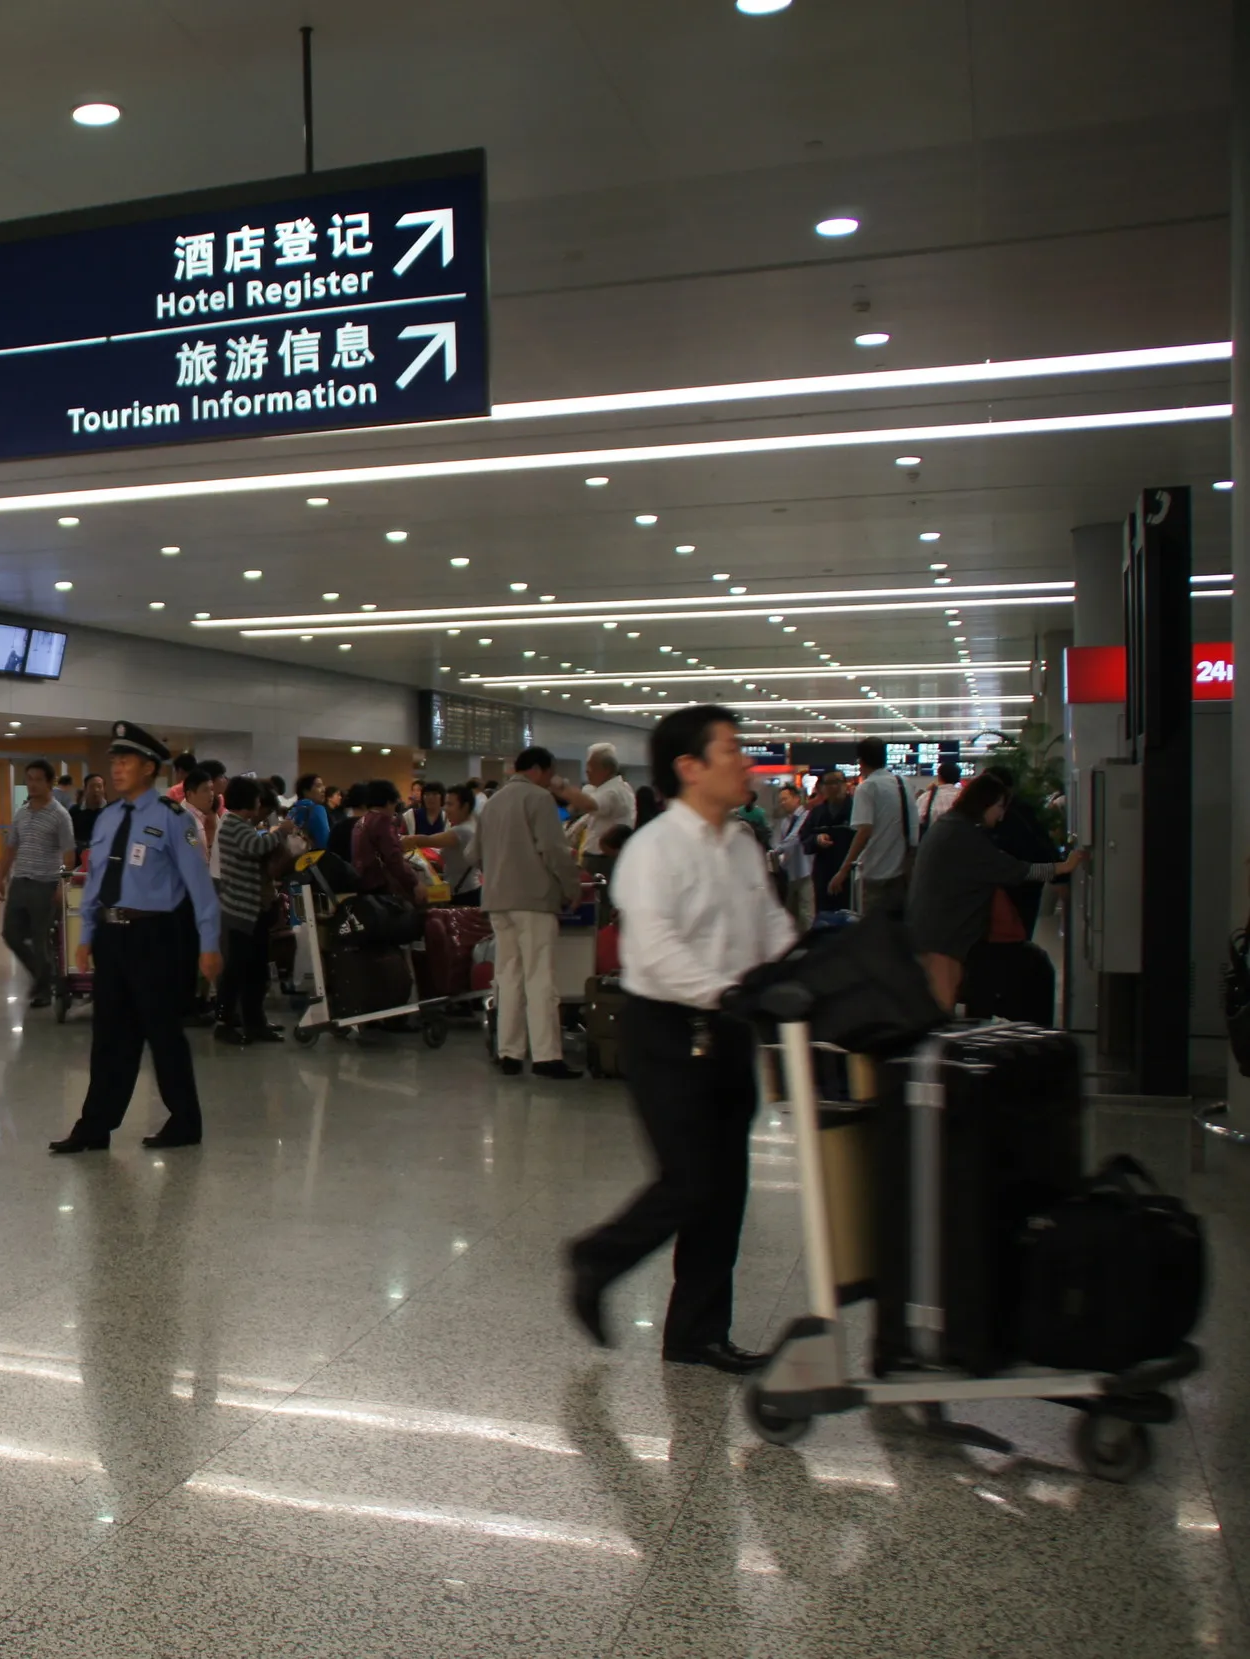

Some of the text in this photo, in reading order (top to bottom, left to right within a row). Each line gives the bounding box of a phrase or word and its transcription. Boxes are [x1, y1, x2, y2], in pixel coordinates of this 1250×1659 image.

[173, 212, 374, 281] 酒店登记
[156, 270, 374, 319] Hotel Register
[175, 321, 375, 387] 旅游信息
[66, 379, 377, 434] Tourism Information
